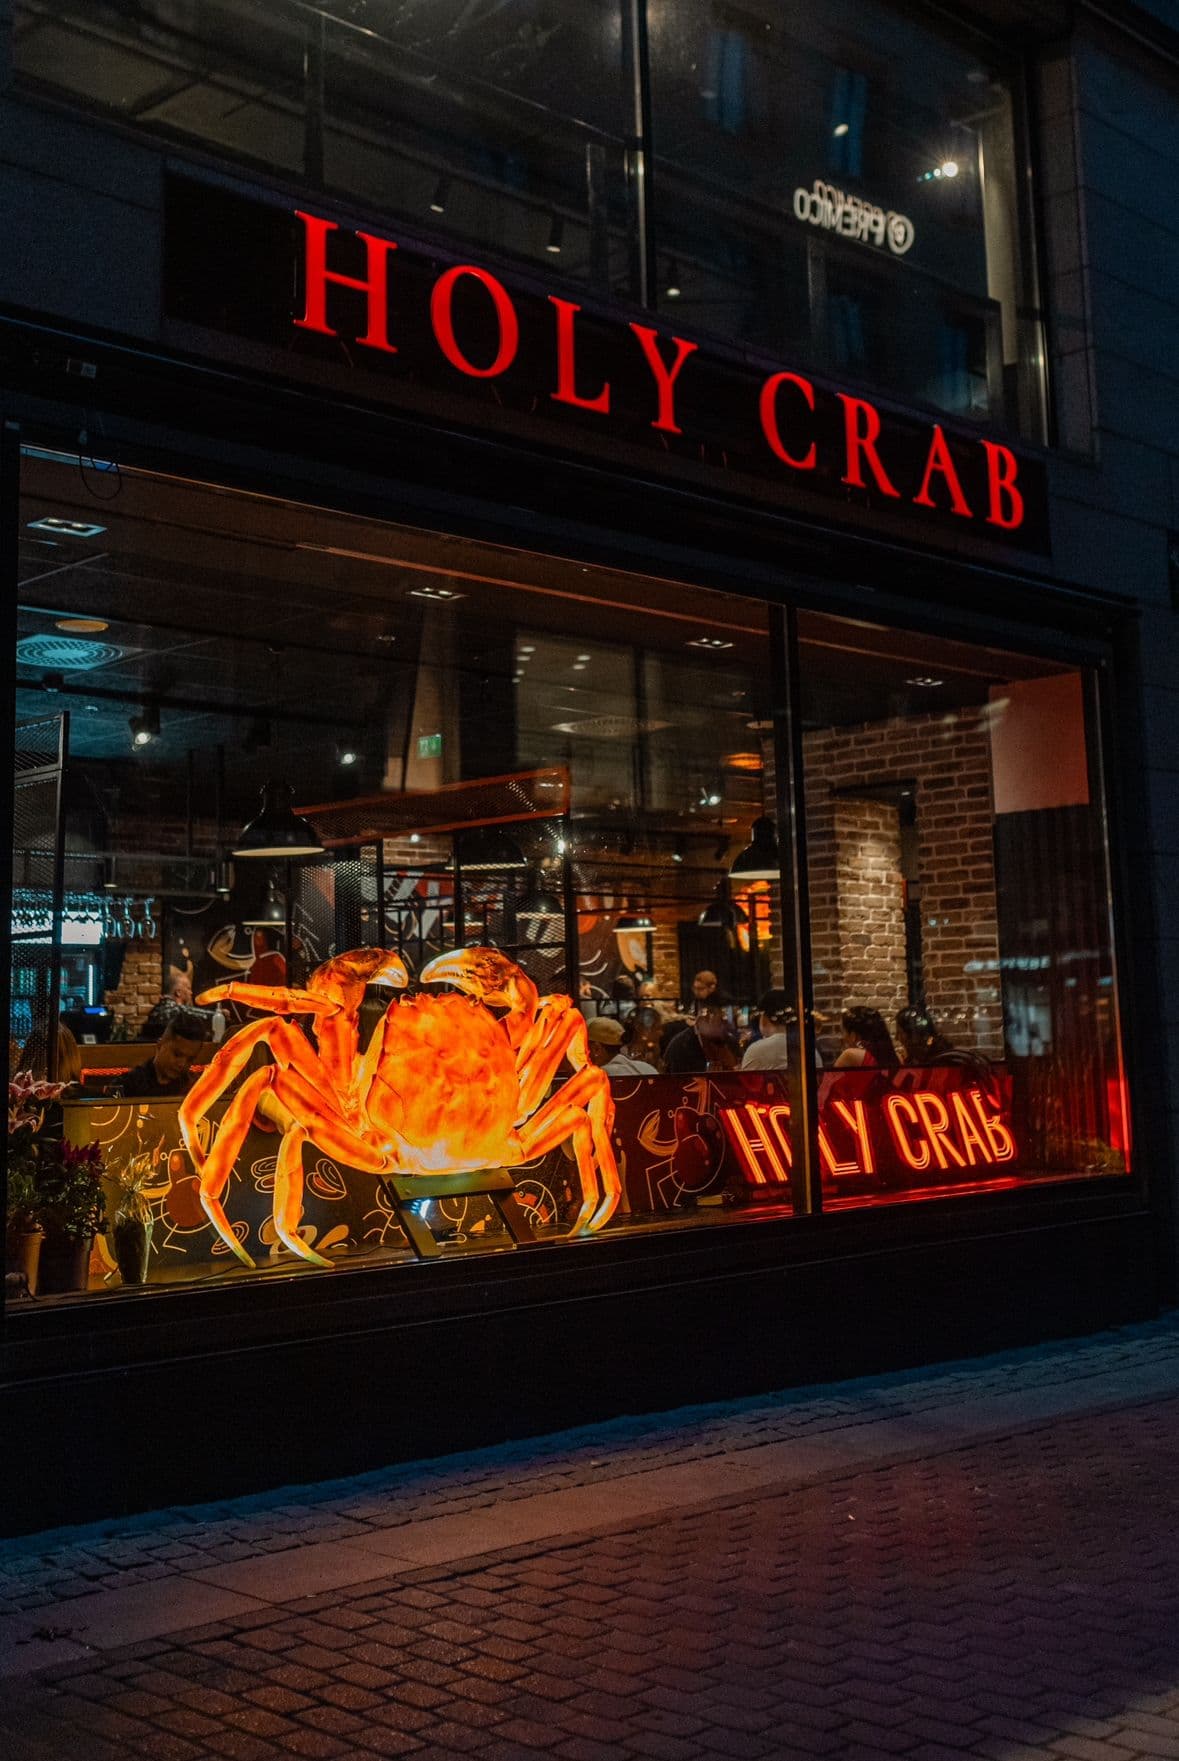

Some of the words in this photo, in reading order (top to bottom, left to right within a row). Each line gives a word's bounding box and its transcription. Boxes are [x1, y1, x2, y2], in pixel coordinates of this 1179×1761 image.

[293, 209, 699, 434] HOLY
[759, 371, 1025, 530] CRAB
[887, 1090, 1014, 1170] CRAB
